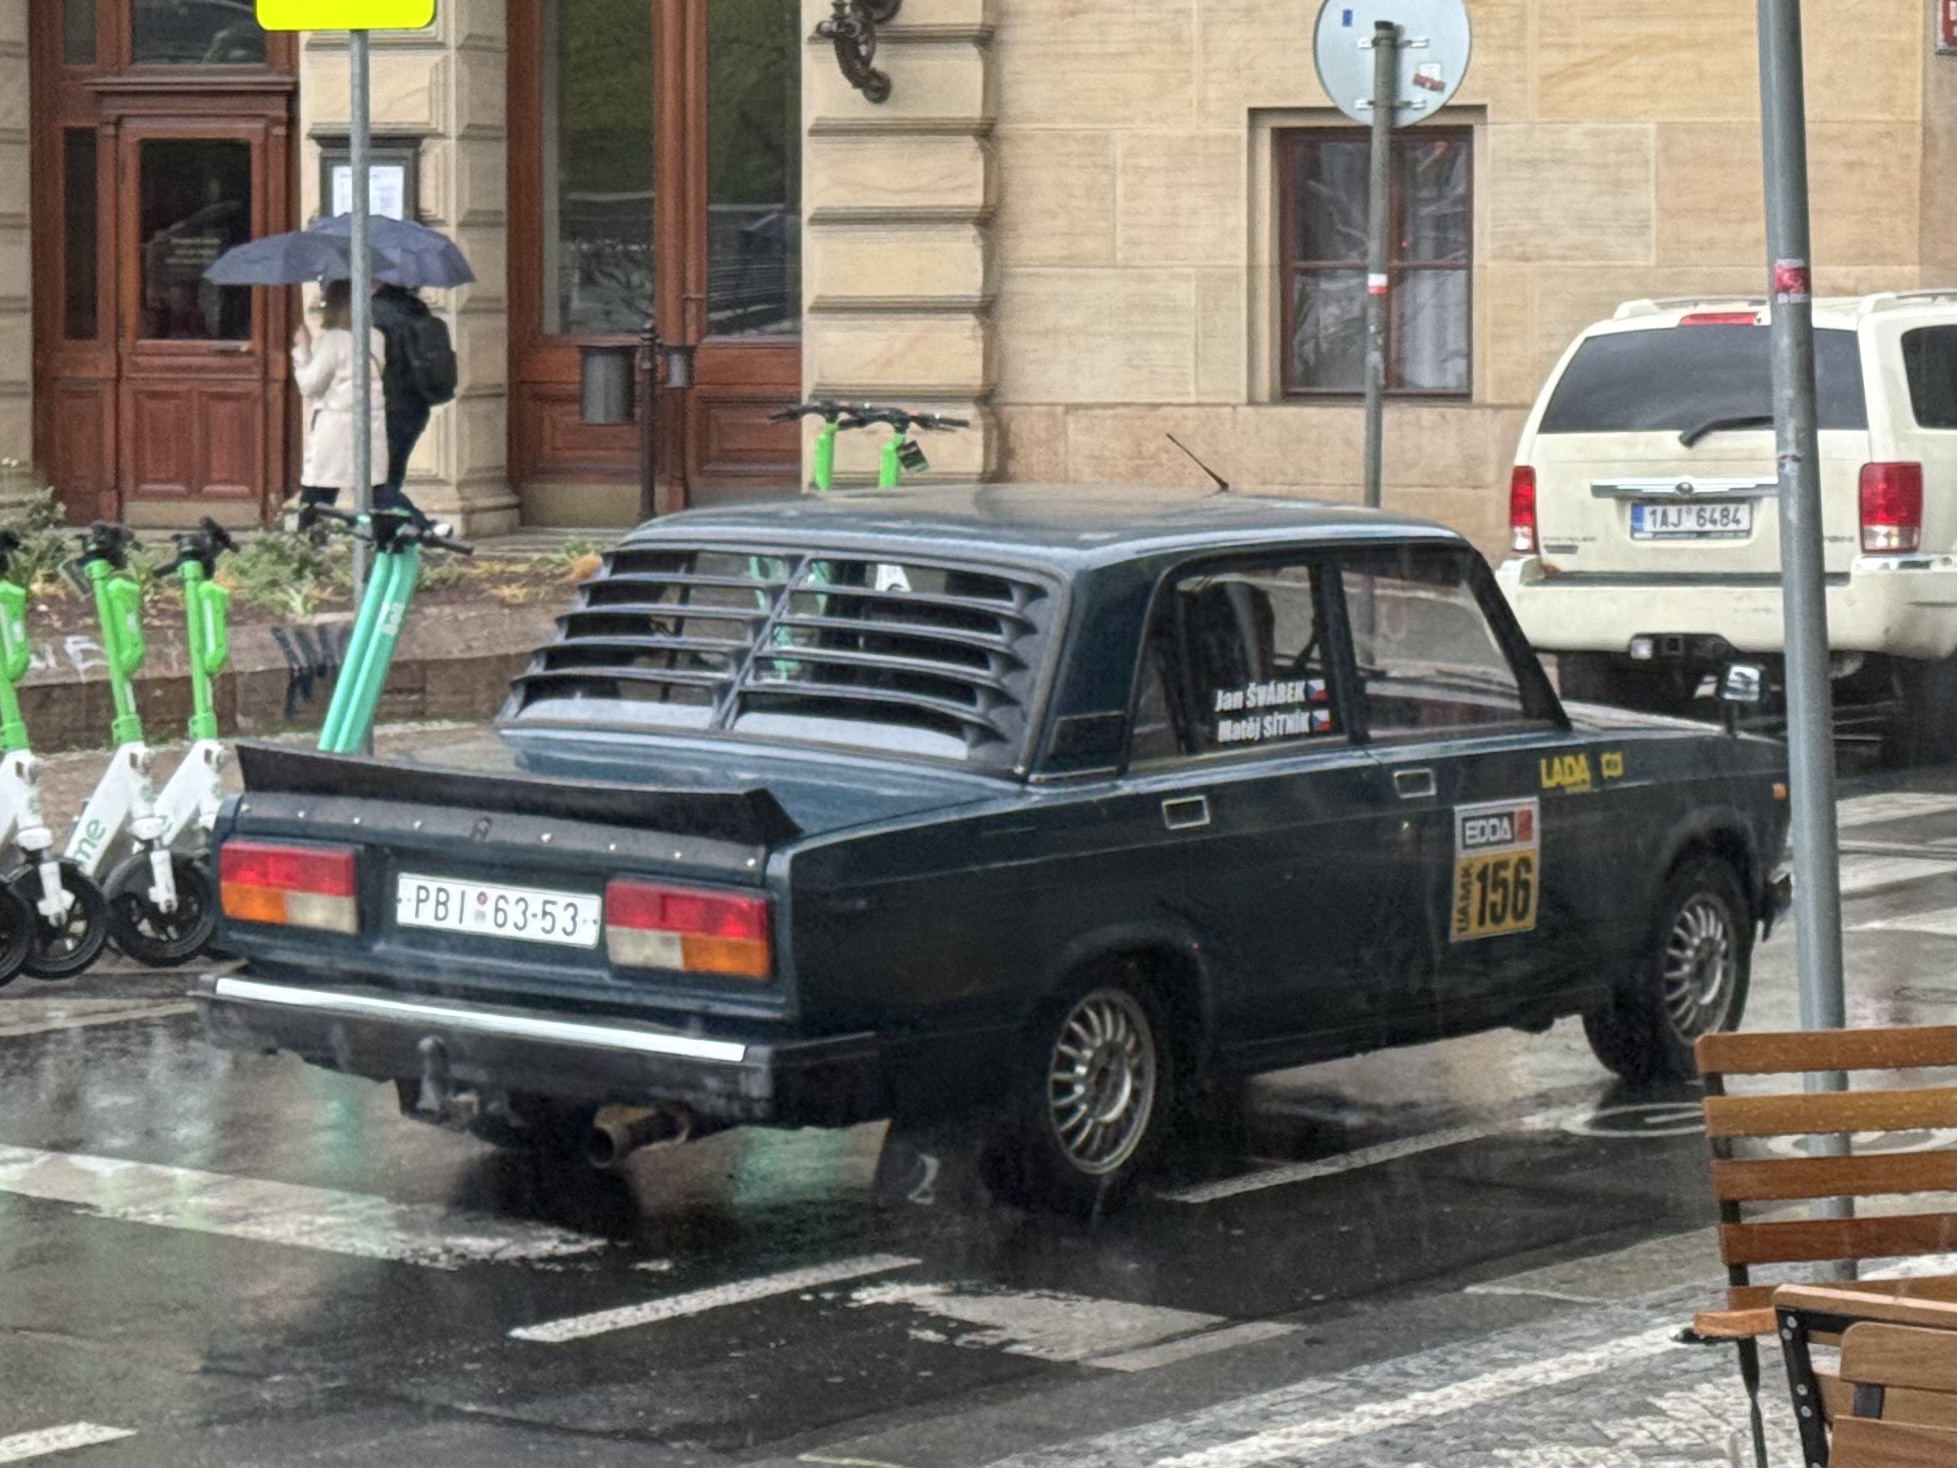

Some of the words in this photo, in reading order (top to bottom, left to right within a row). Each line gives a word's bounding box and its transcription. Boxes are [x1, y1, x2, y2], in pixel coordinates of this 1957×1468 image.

[1649, 507, 1682, 528] 1AJ
[1696, 506, 1741, 527] 6484
[1214, 690, 1244, 712] Jan
[1540, 753, 1591, 789] LADA
[1464, 816, 1513, 845] EDDA
[414, 884, 466, 925] PBI
[1476, 856, 1532, 928] 156
